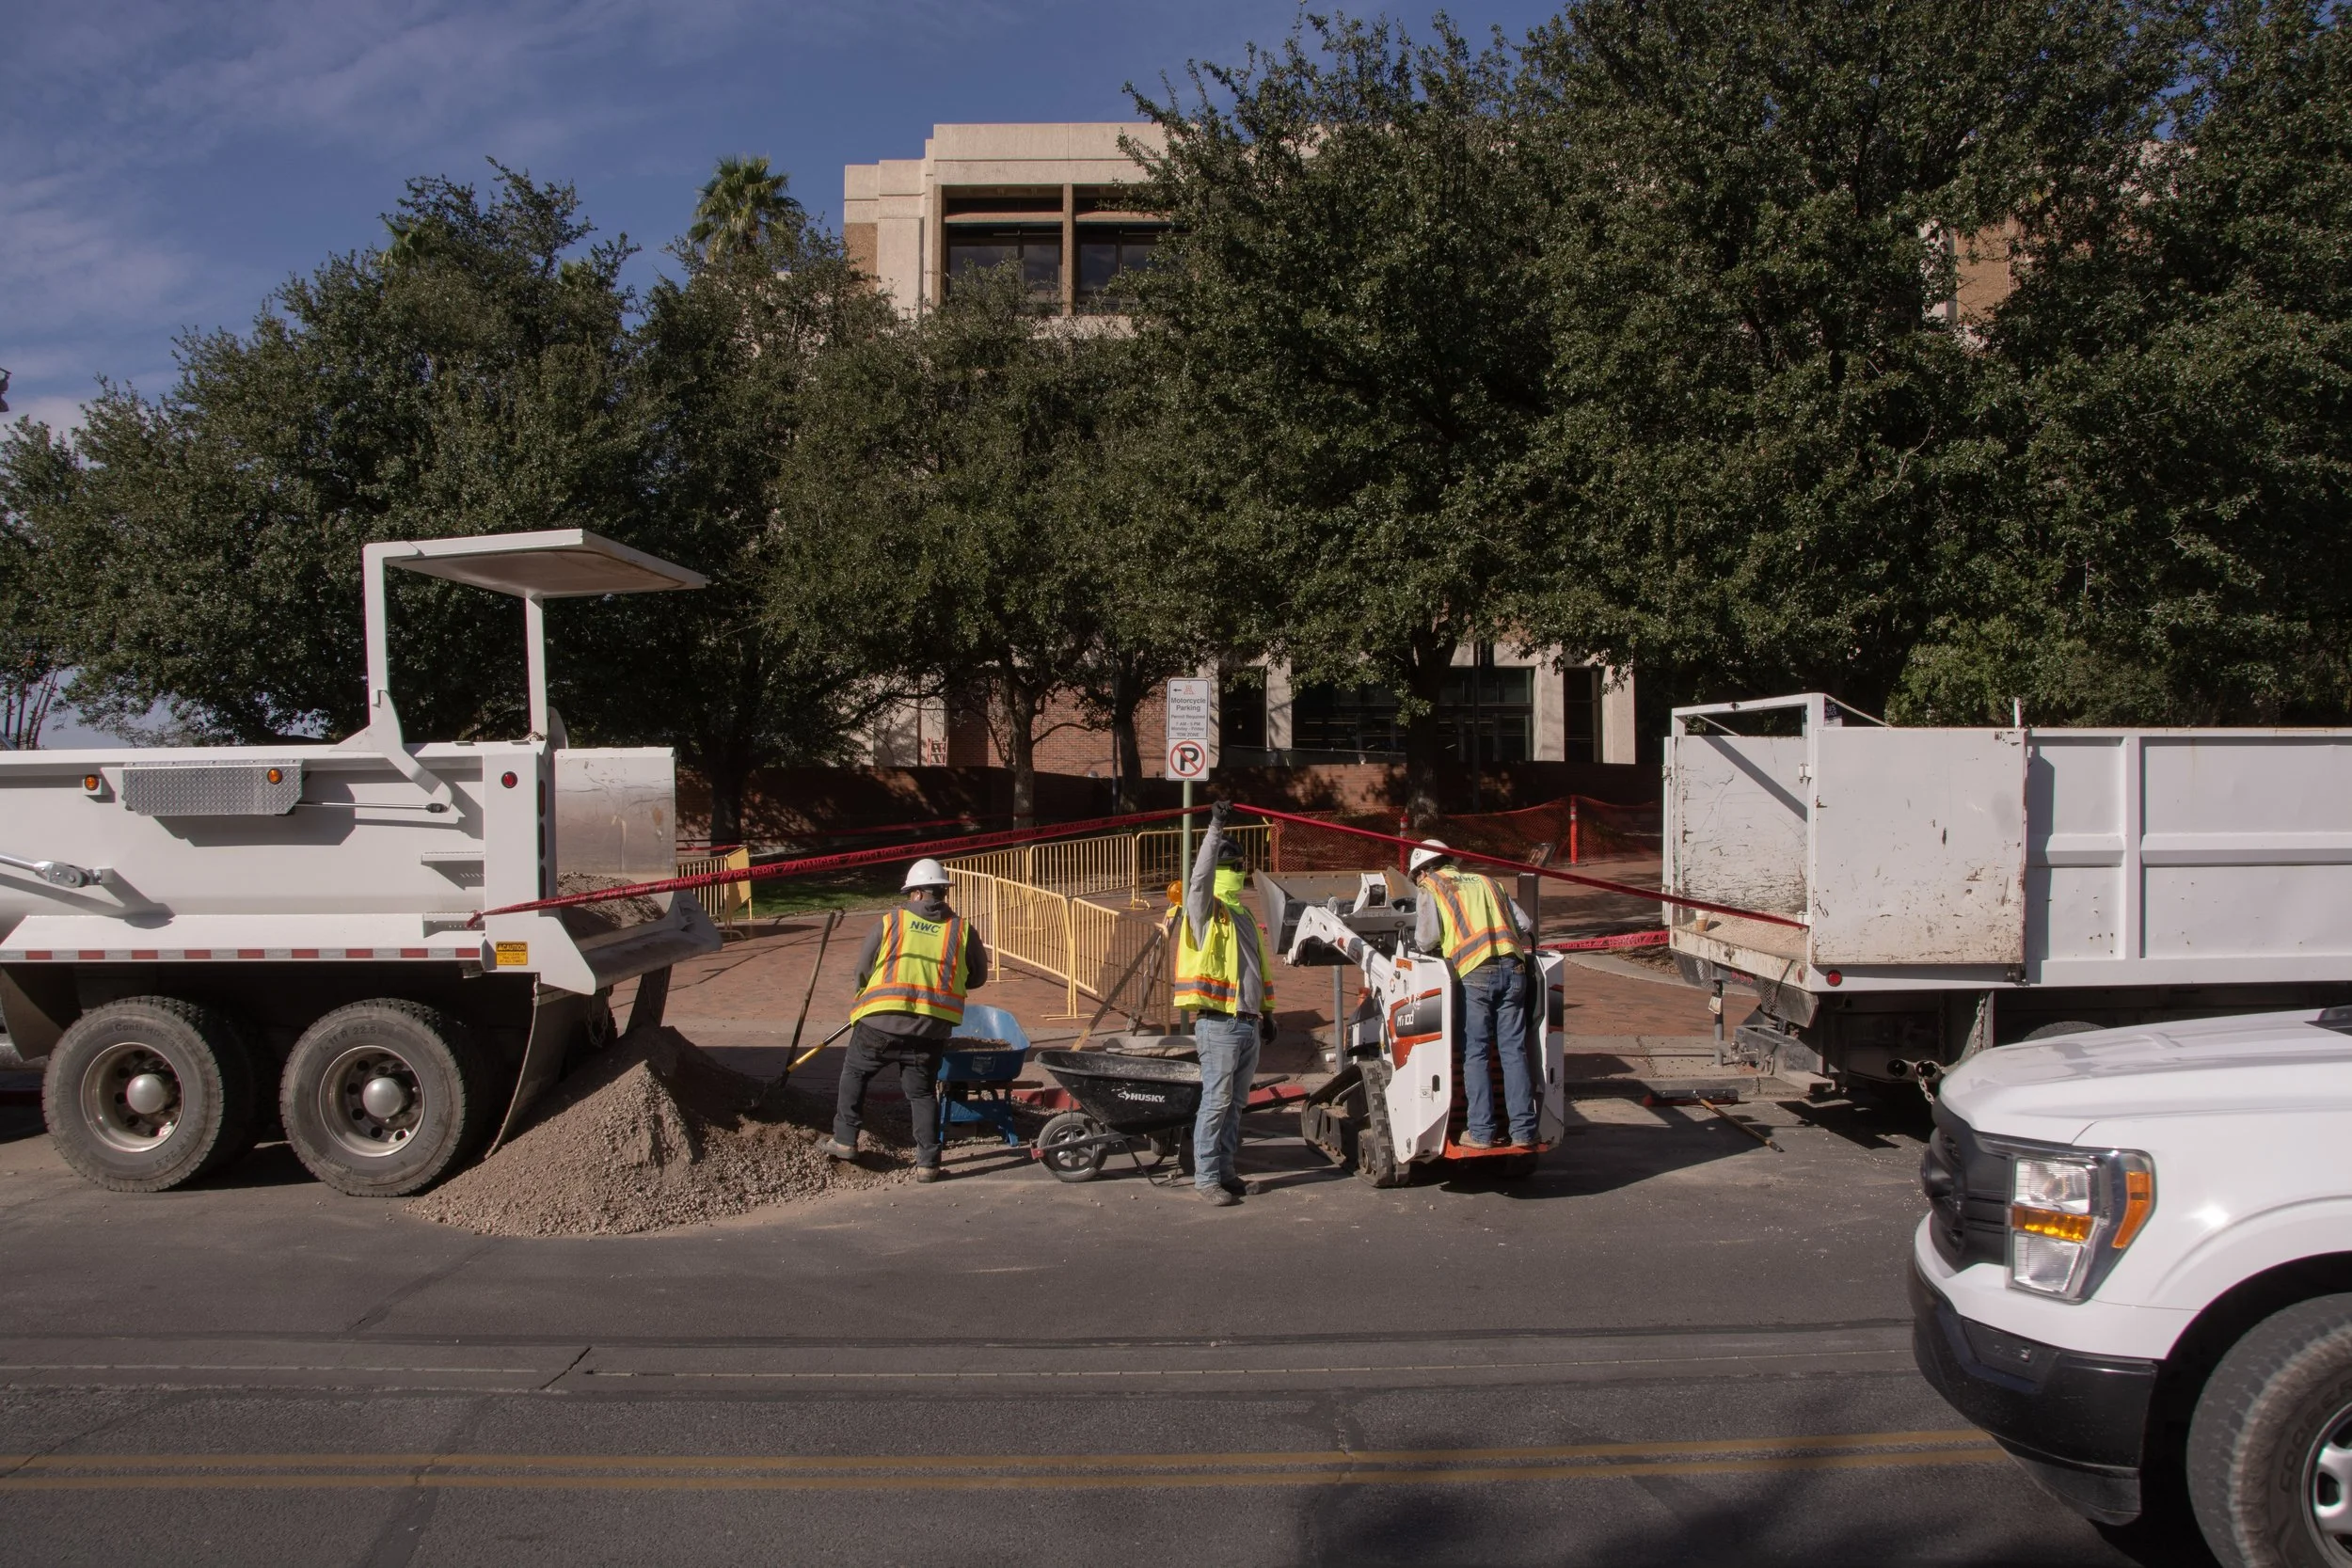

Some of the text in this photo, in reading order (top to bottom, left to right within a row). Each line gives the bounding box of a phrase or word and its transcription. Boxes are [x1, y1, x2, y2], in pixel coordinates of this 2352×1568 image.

[1180, 747, 1199, 771] P
[733, 867, 776, 879] PELIGRO
[799, 857, 840, 870] DANGER
[864, 847, 905, 862] PELIGRO
[910, 921, 941, 933] NWC
[1130, 1093, 1166, 1102] HUSKY
